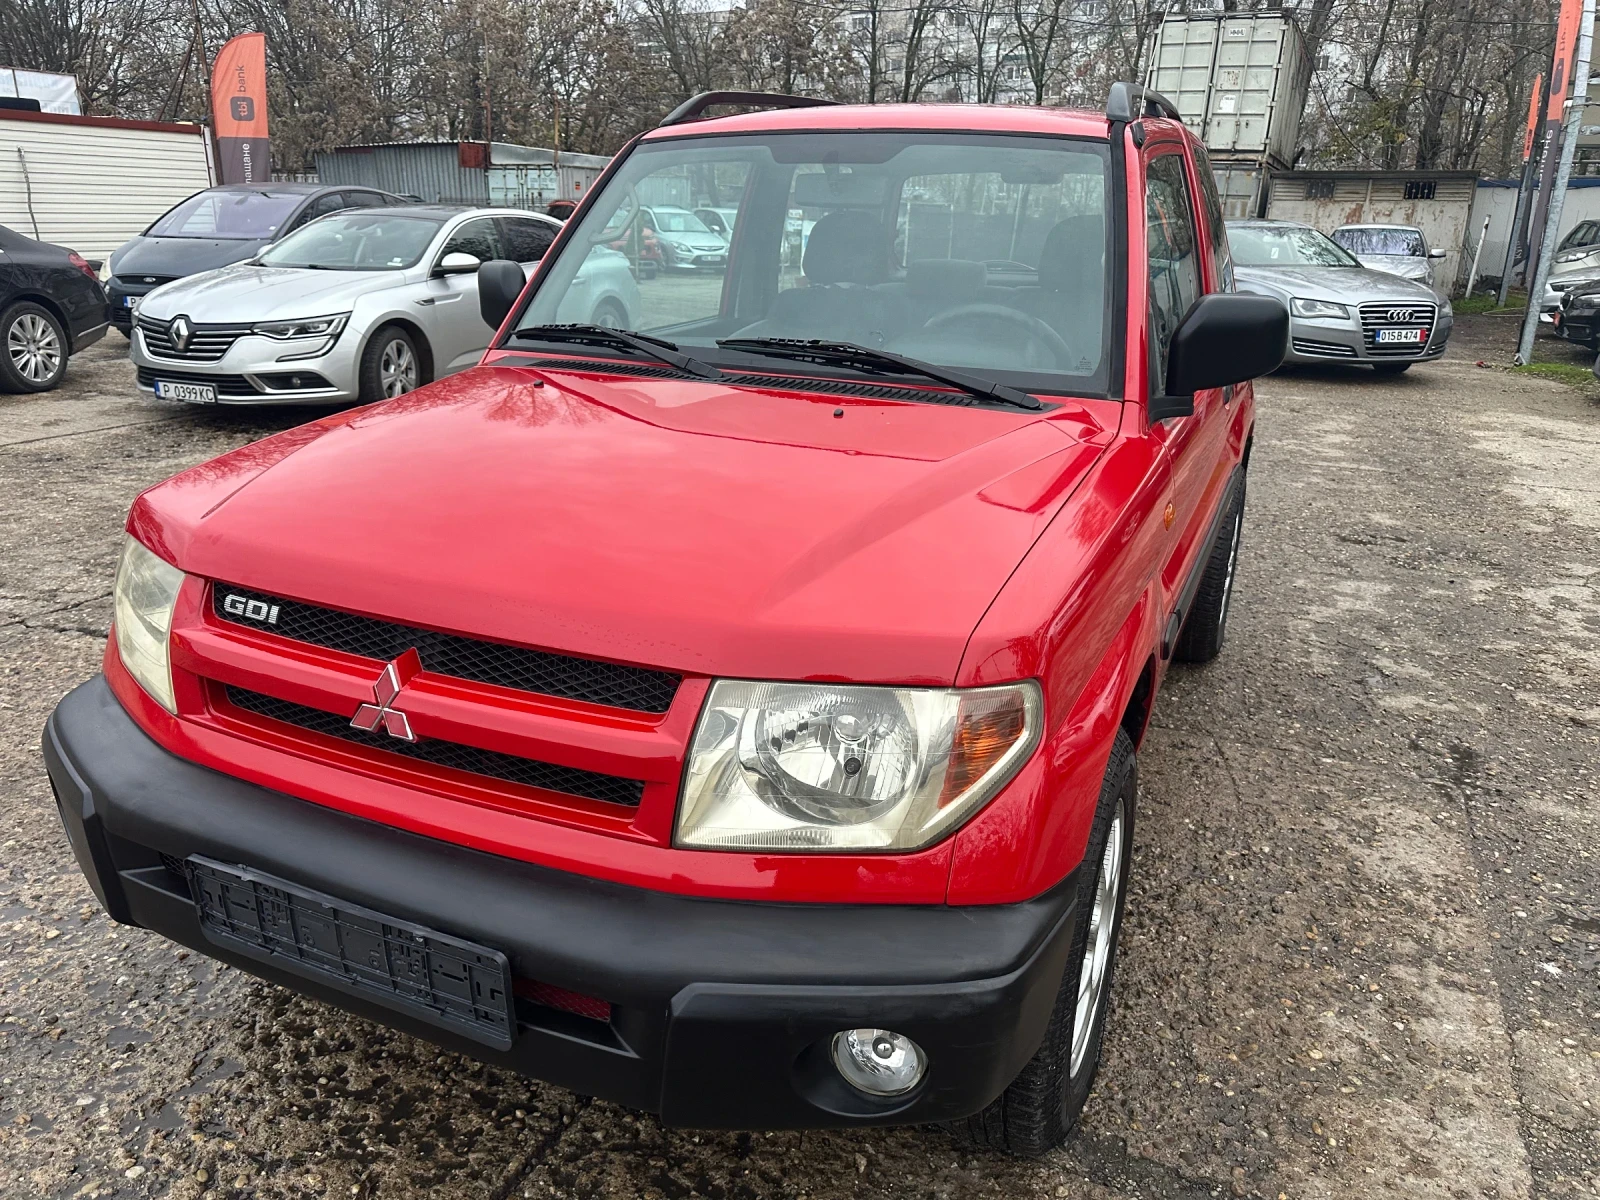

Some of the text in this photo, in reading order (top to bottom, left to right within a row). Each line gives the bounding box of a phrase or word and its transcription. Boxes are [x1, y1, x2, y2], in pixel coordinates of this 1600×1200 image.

[235, 65, 249, 117] tbi bank
[163, 384, 170, 396] P
[223, 594, 280, 624] GDI
